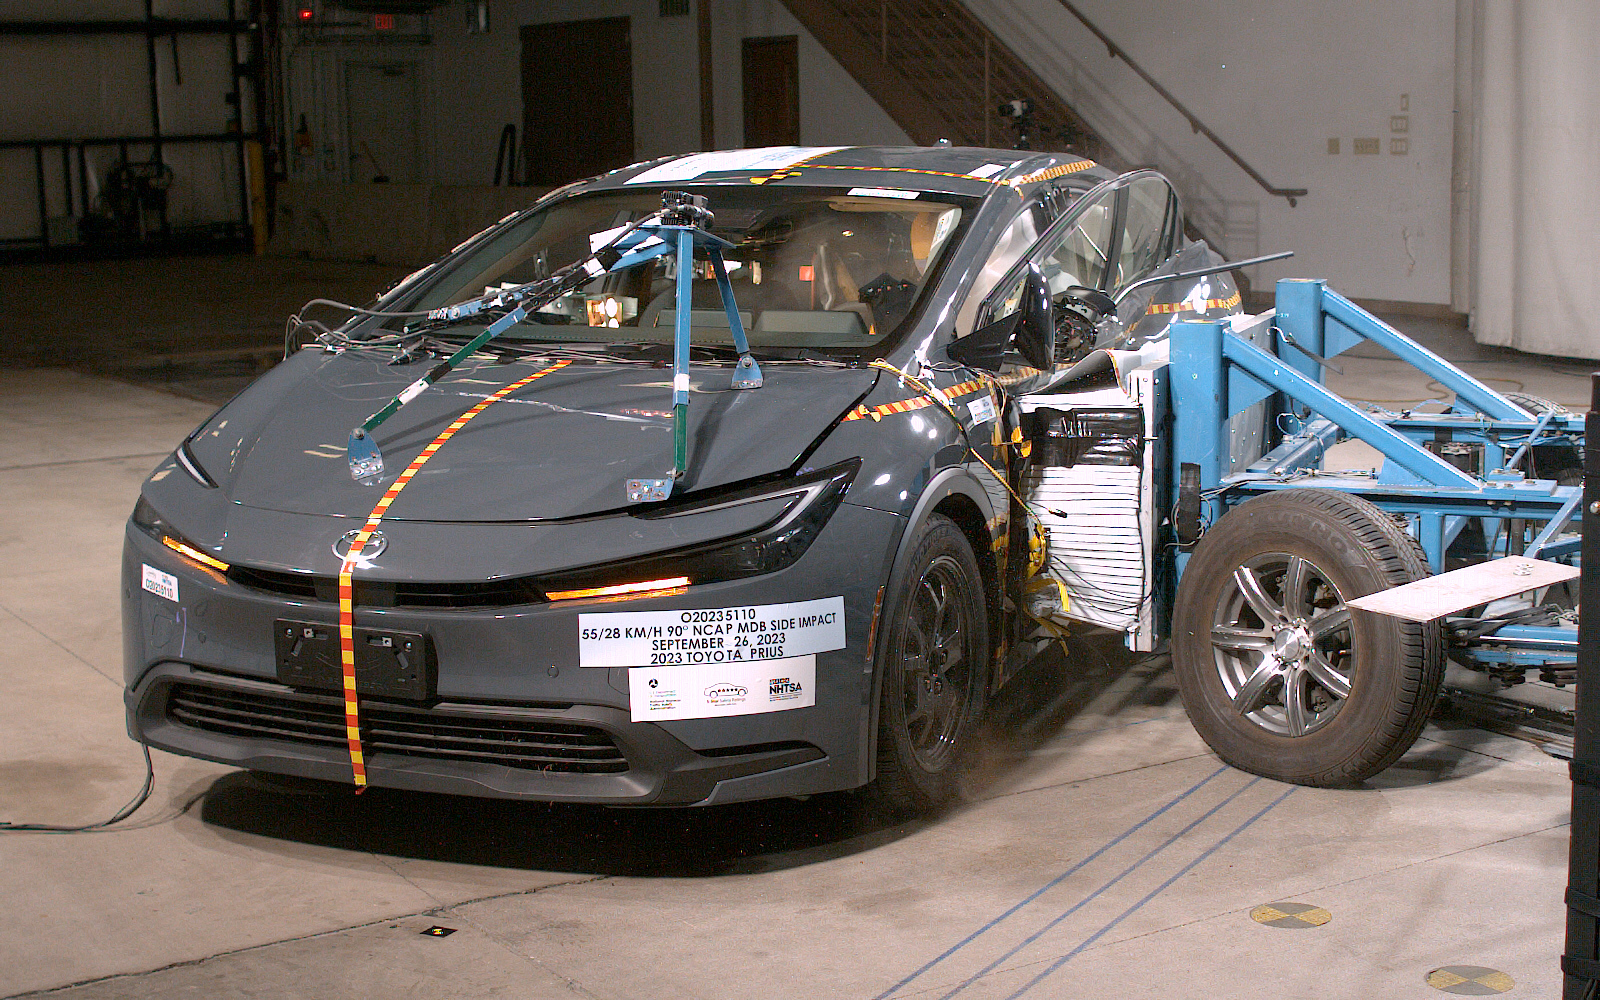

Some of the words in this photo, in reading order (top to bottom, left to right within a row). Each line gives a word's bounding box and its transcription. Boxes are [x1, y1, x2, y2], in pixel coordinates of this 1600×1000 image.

[582, 627, 621, 641] 55/28
[625, 626, 662, 640] KM/H
[693, 623, 733, 636] NCAP
[737, 621, 767, 634] MDB
[770, 618, 796, 631] SIDE
[798, 612, 837, 628] IMPACT
[652, 637, 724, 651] SEPTEMBER
[734, 635, 753, 648] 26,
[757, 632, 786, 645] 2023
[650, 652, 683, 664] 2023
[686, 649, 742, 662] TOYOTA
[750, 645, 784, 659] PRIUS
[769, 681, 802, 695] NHTSA
